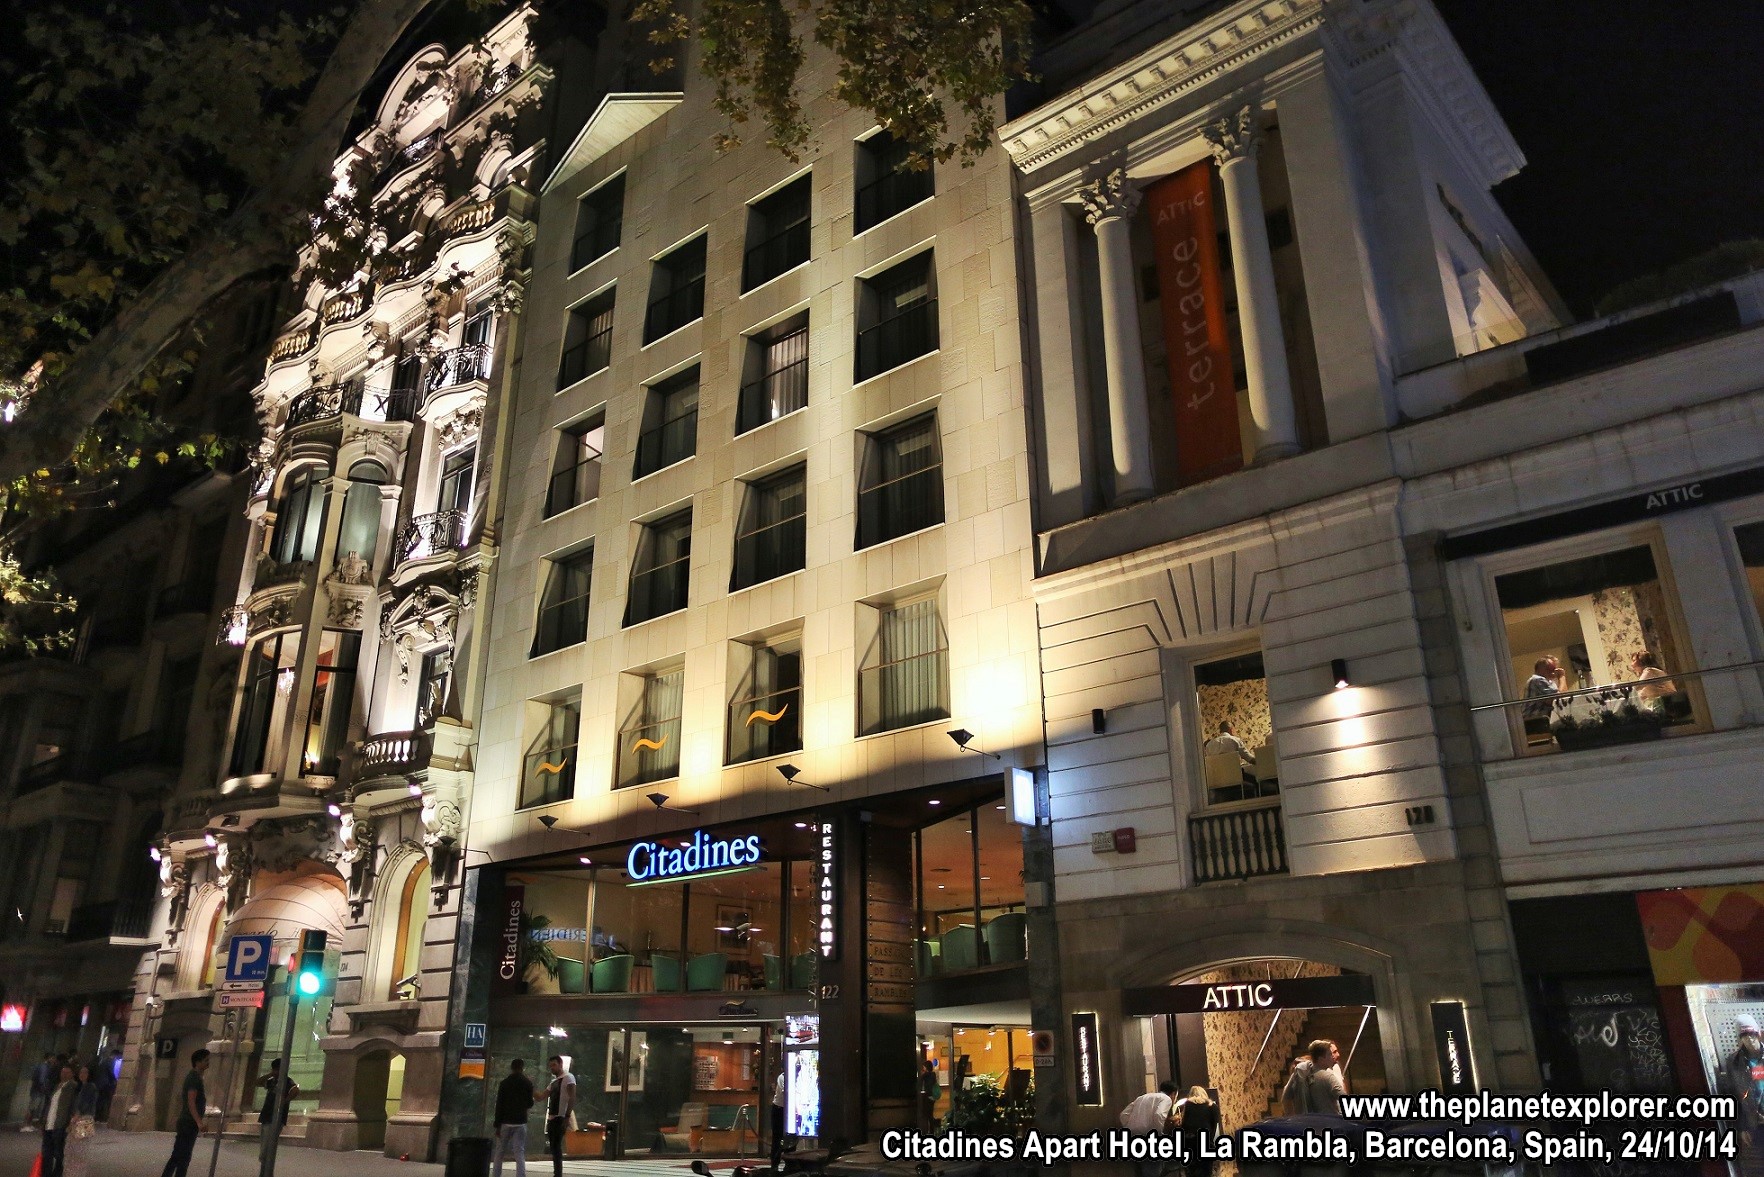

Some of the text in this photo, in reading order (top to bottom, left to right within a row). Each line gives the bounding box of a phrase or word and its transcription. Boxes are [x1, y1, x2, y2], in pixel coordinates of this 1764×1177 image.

[1157, 190, 1205, 226] ATTIC
[1173, 236, 1215, 410] terrace
[1646, 483, 1704, 510] ATTIC
[628, 829, 760, 880] Citadines
[820, 823, 834, 957] RESTAURANT
[233, 940, 262, 975] P
[500, 900, 521, 980] Citadines
[822, 985, 839, 999] 122
[1203, 984, 1273, 1009] ATTIC
[467, 1026, 483, 1039] HA
